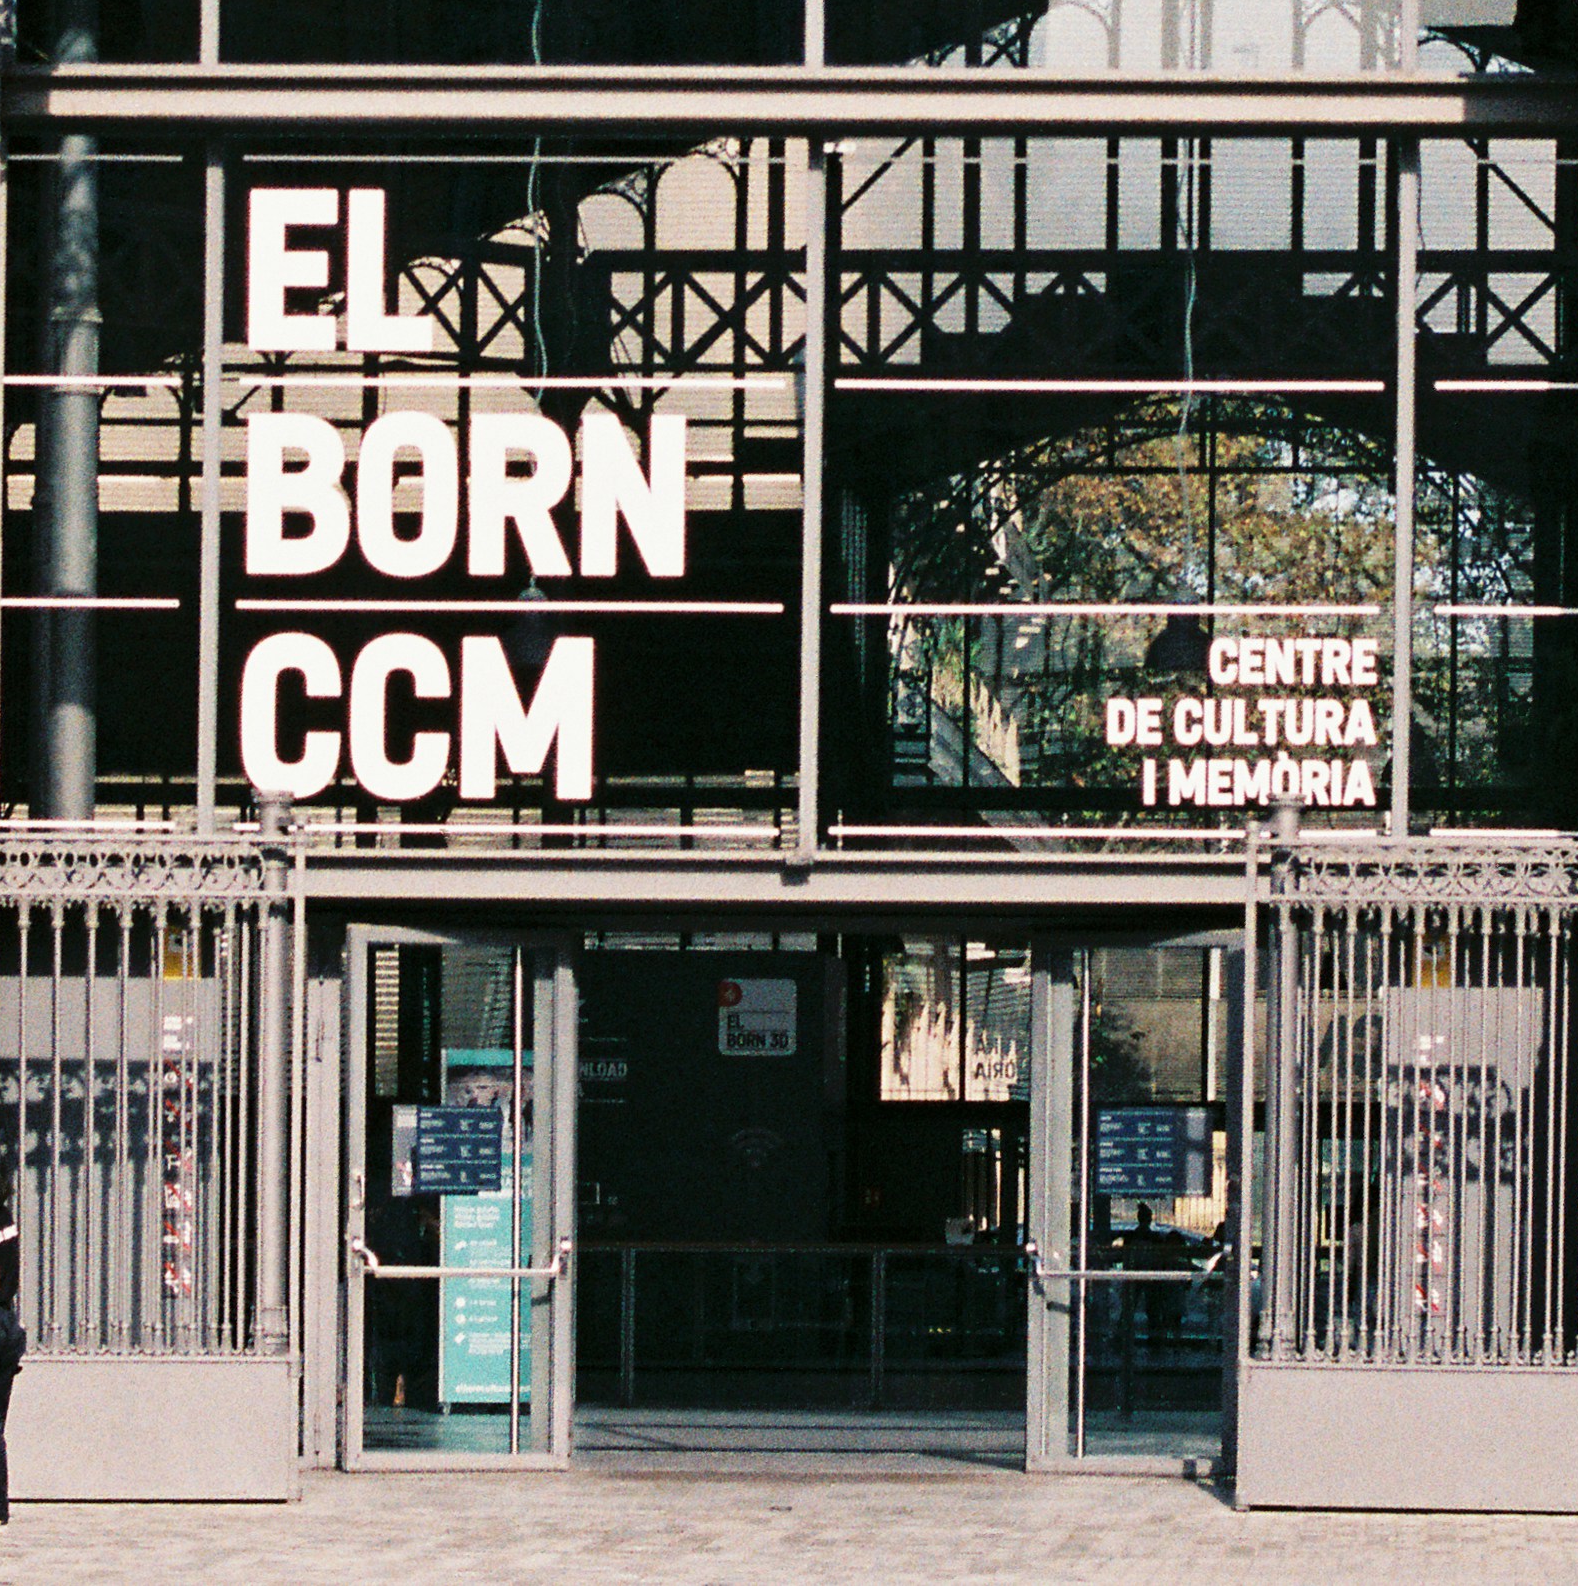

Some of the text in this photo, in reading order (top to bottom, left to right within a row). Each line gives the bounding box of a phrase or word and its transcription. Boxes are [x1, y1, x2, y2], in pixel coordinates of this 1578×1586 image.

[247, 188, 433, 351] EL
[245, 410, 687, 578] BORN
[1209, 637, 1378, 685] CENTRE
[240, 631, 595, 801] CCM
[1106, 697, 1377, 746] DE CULTURA
[1142, 751, 1377, 805] I MEMÒRIA
[726, 1032, 766, 1047] BORN
